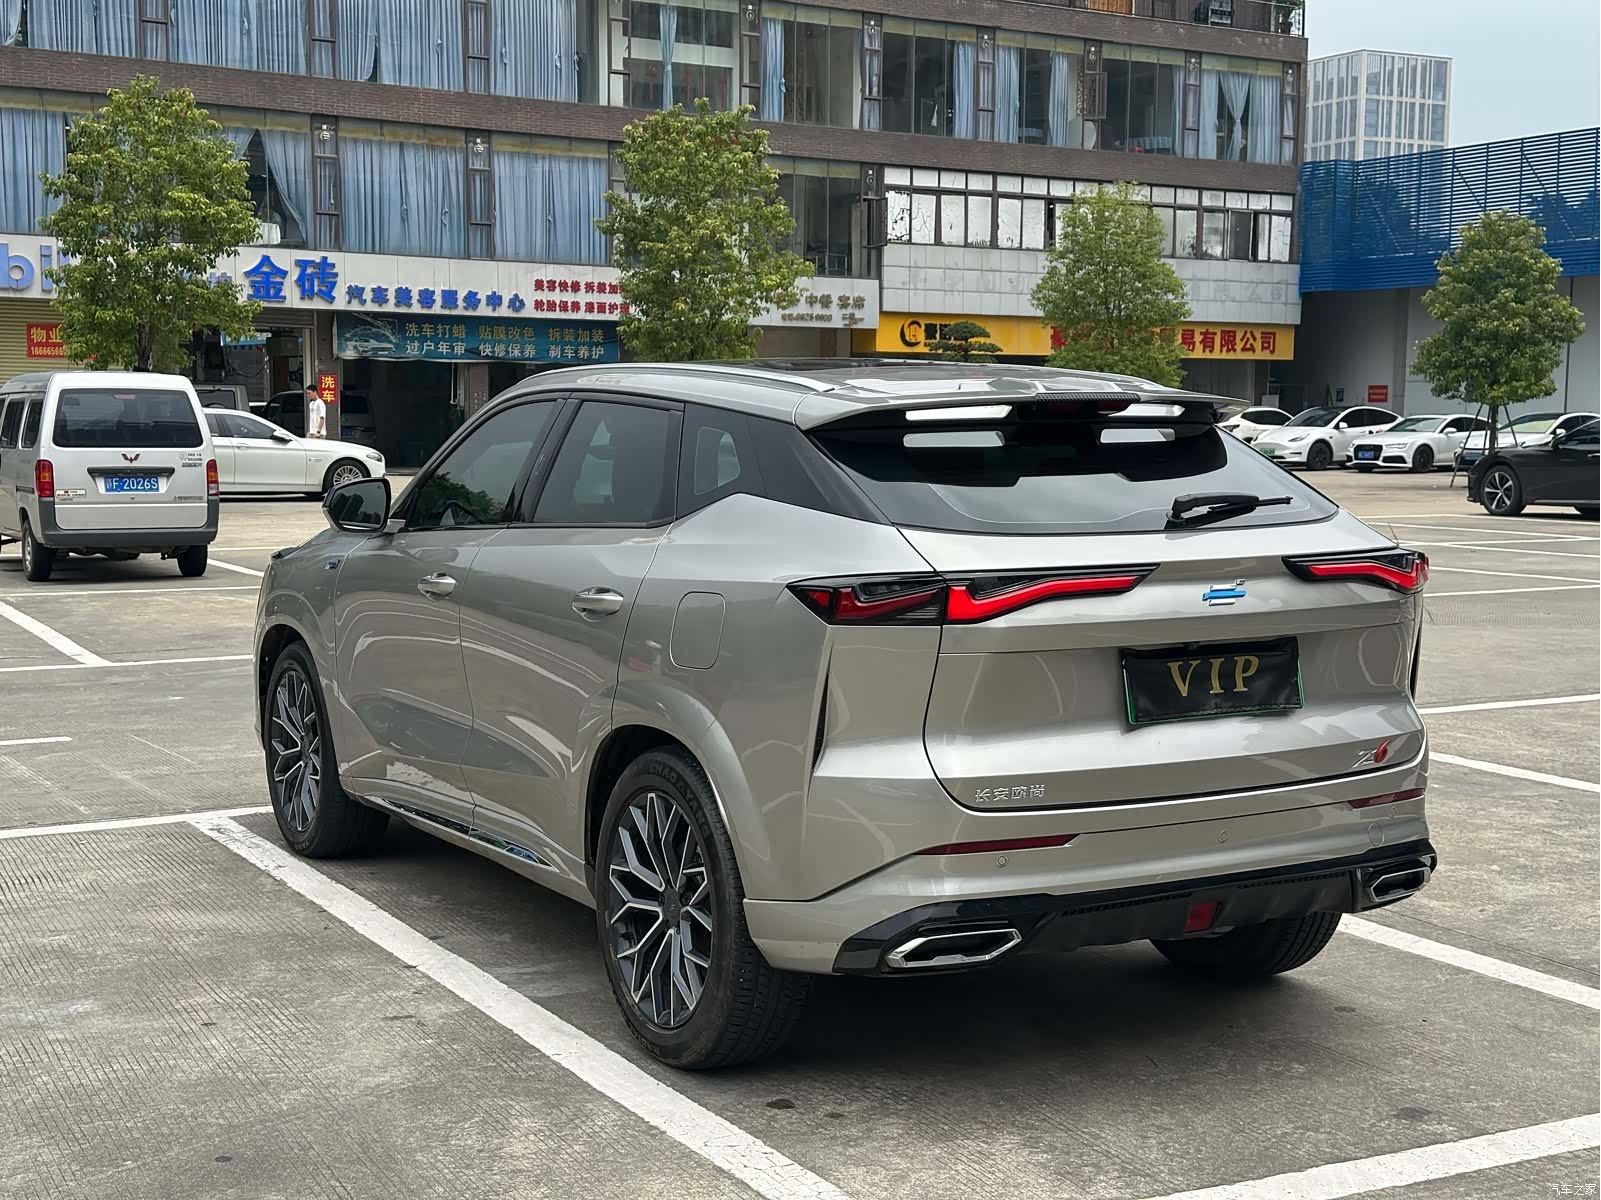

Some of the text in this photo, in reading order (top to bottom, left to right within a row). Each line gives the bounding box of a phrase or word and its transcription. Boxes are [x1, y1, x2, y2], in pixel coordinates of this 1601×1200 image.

[243, 254, 339, 304] 金砖
[534, 278, 581, 294] 美容快修
[346, 284, 526, 312] 汽车美容服务中心
[534, 298, 581, 313] 轮胎保养
[405, 322, 604, 342] 洗车打蜡 贴膜改色 拆装加装
[1160, 328, 1277, 354] 易有限公司
[405, 340, 604, 360] 过户年审 快修保养 刹车养护
[321, 376, 335, 403] 洗车
[1167, 654, 1262, 697] VIP
[975, 784, 1046, 803] 长安欧尚
